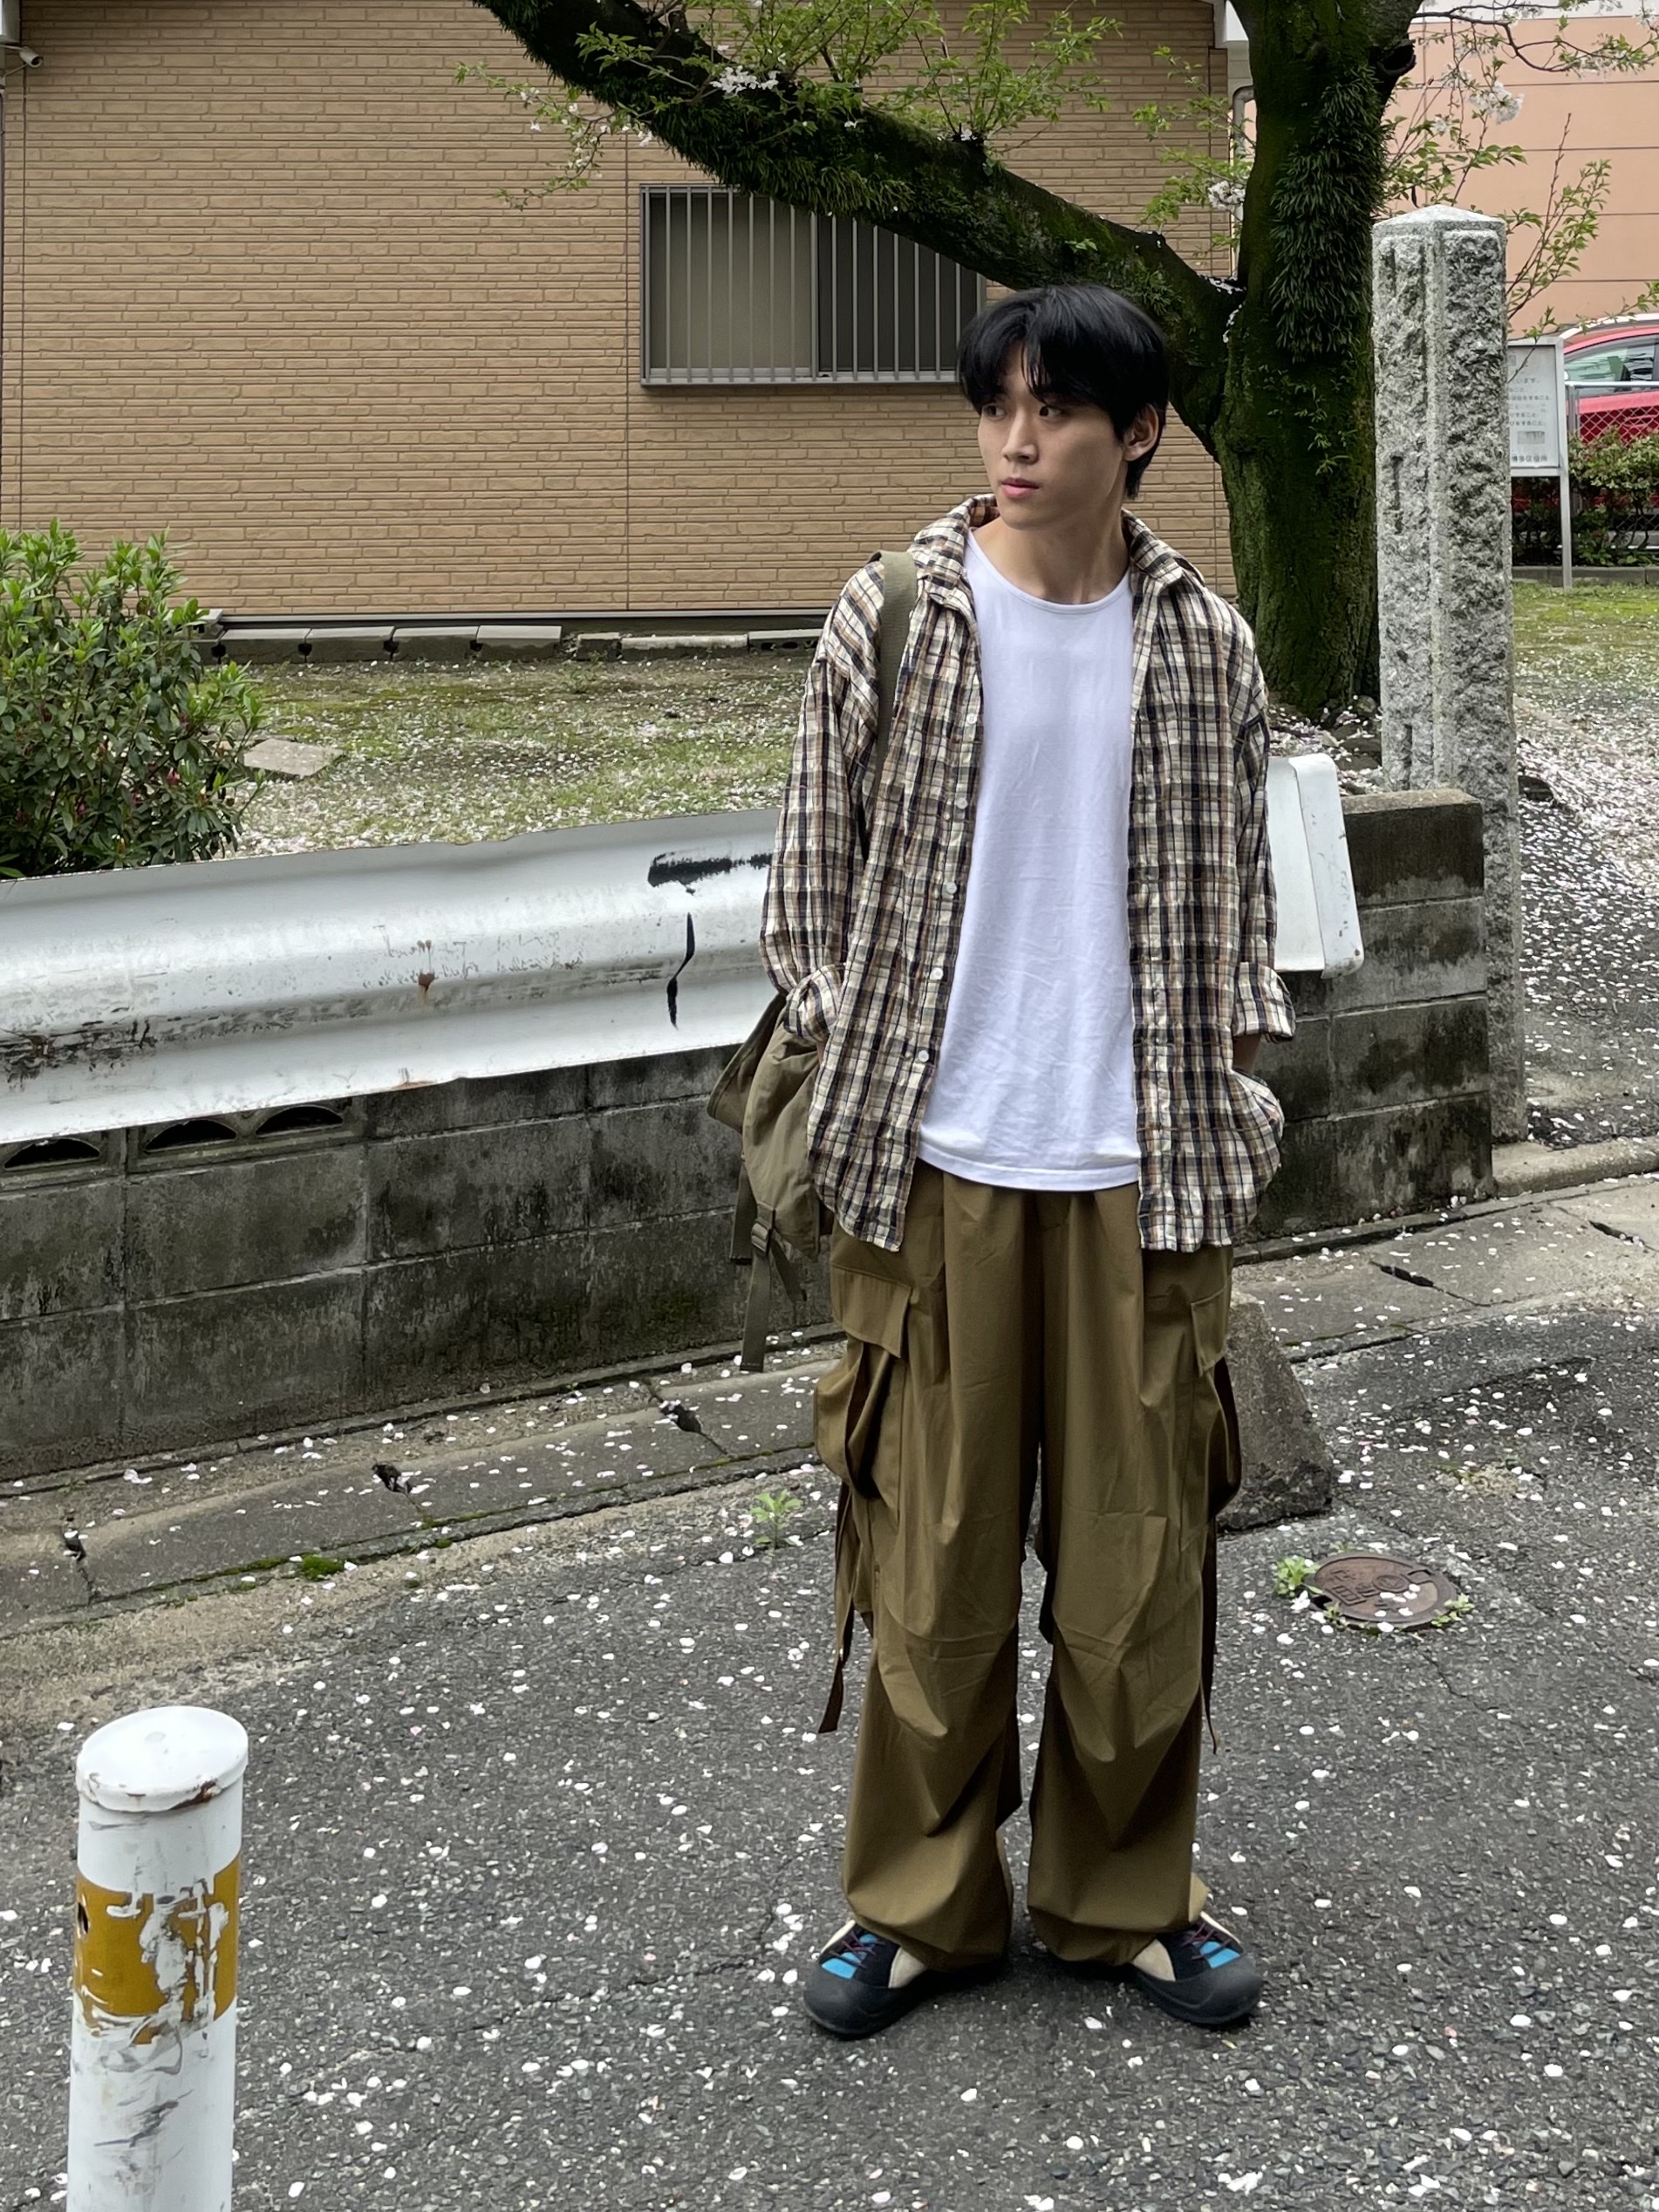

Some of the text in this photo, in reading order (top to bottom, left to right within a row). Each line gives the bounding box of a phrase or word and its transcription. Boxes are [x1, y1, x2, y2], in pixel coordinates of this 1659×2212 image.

[1512, 454, 1547, 462] 博多区役所
